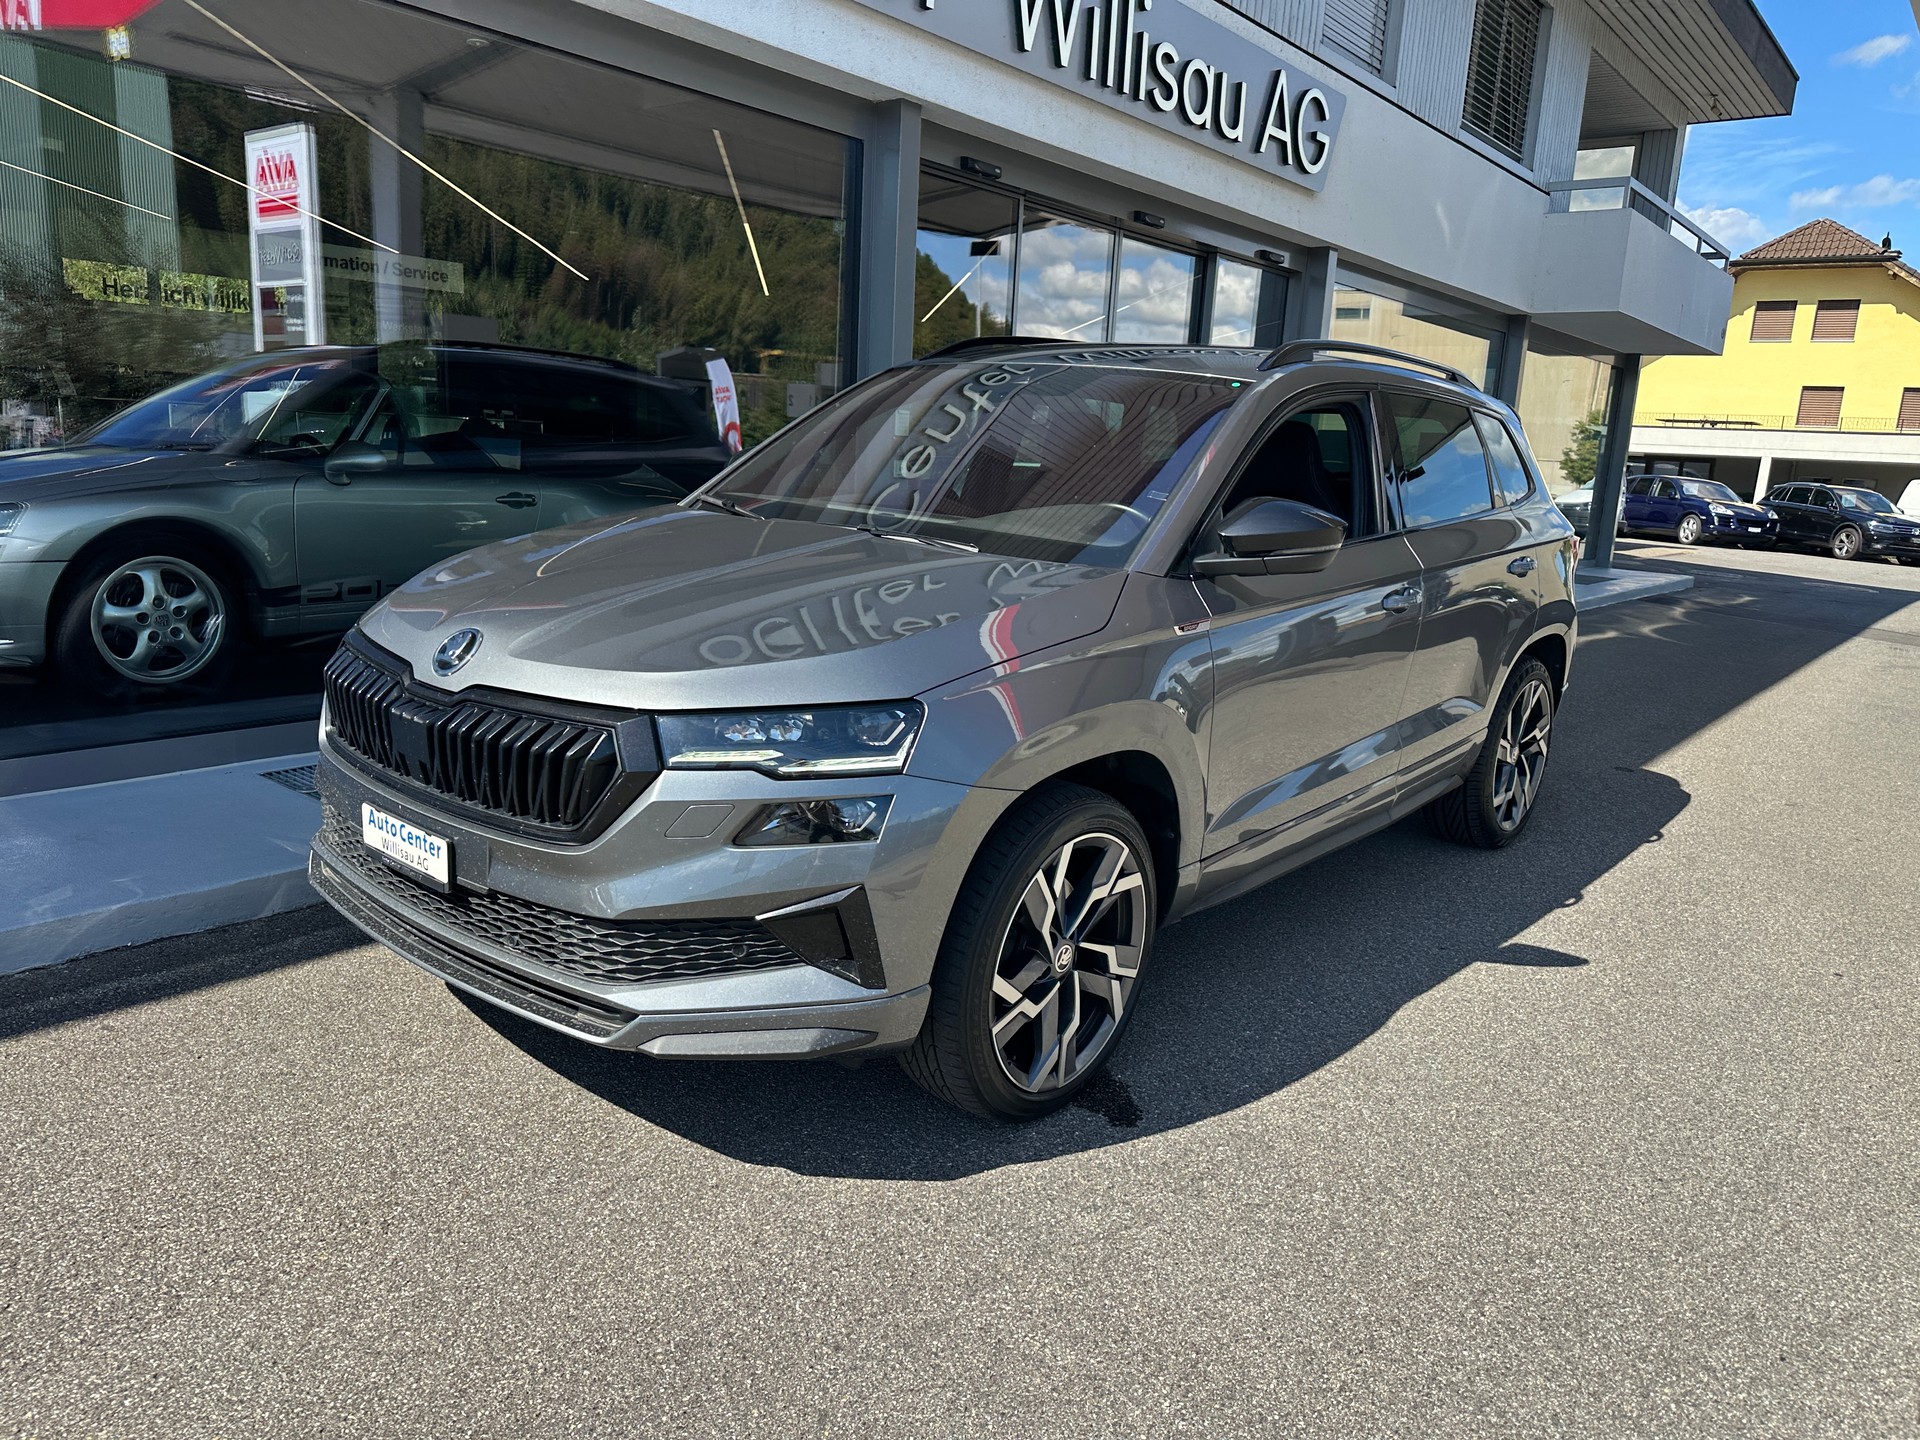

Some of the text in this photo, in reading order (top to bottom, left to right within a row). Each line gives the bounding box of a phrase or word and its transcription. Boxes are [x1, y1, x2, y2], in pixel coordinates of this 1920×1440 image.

[1012, 0, 1331, 175] Willisau AG
[322, 256, 379, 274] mation
[392, 262, 449, 283] Service
[381, 836, 415, 864] Willisau
[416, 855, 429, 872] AG
